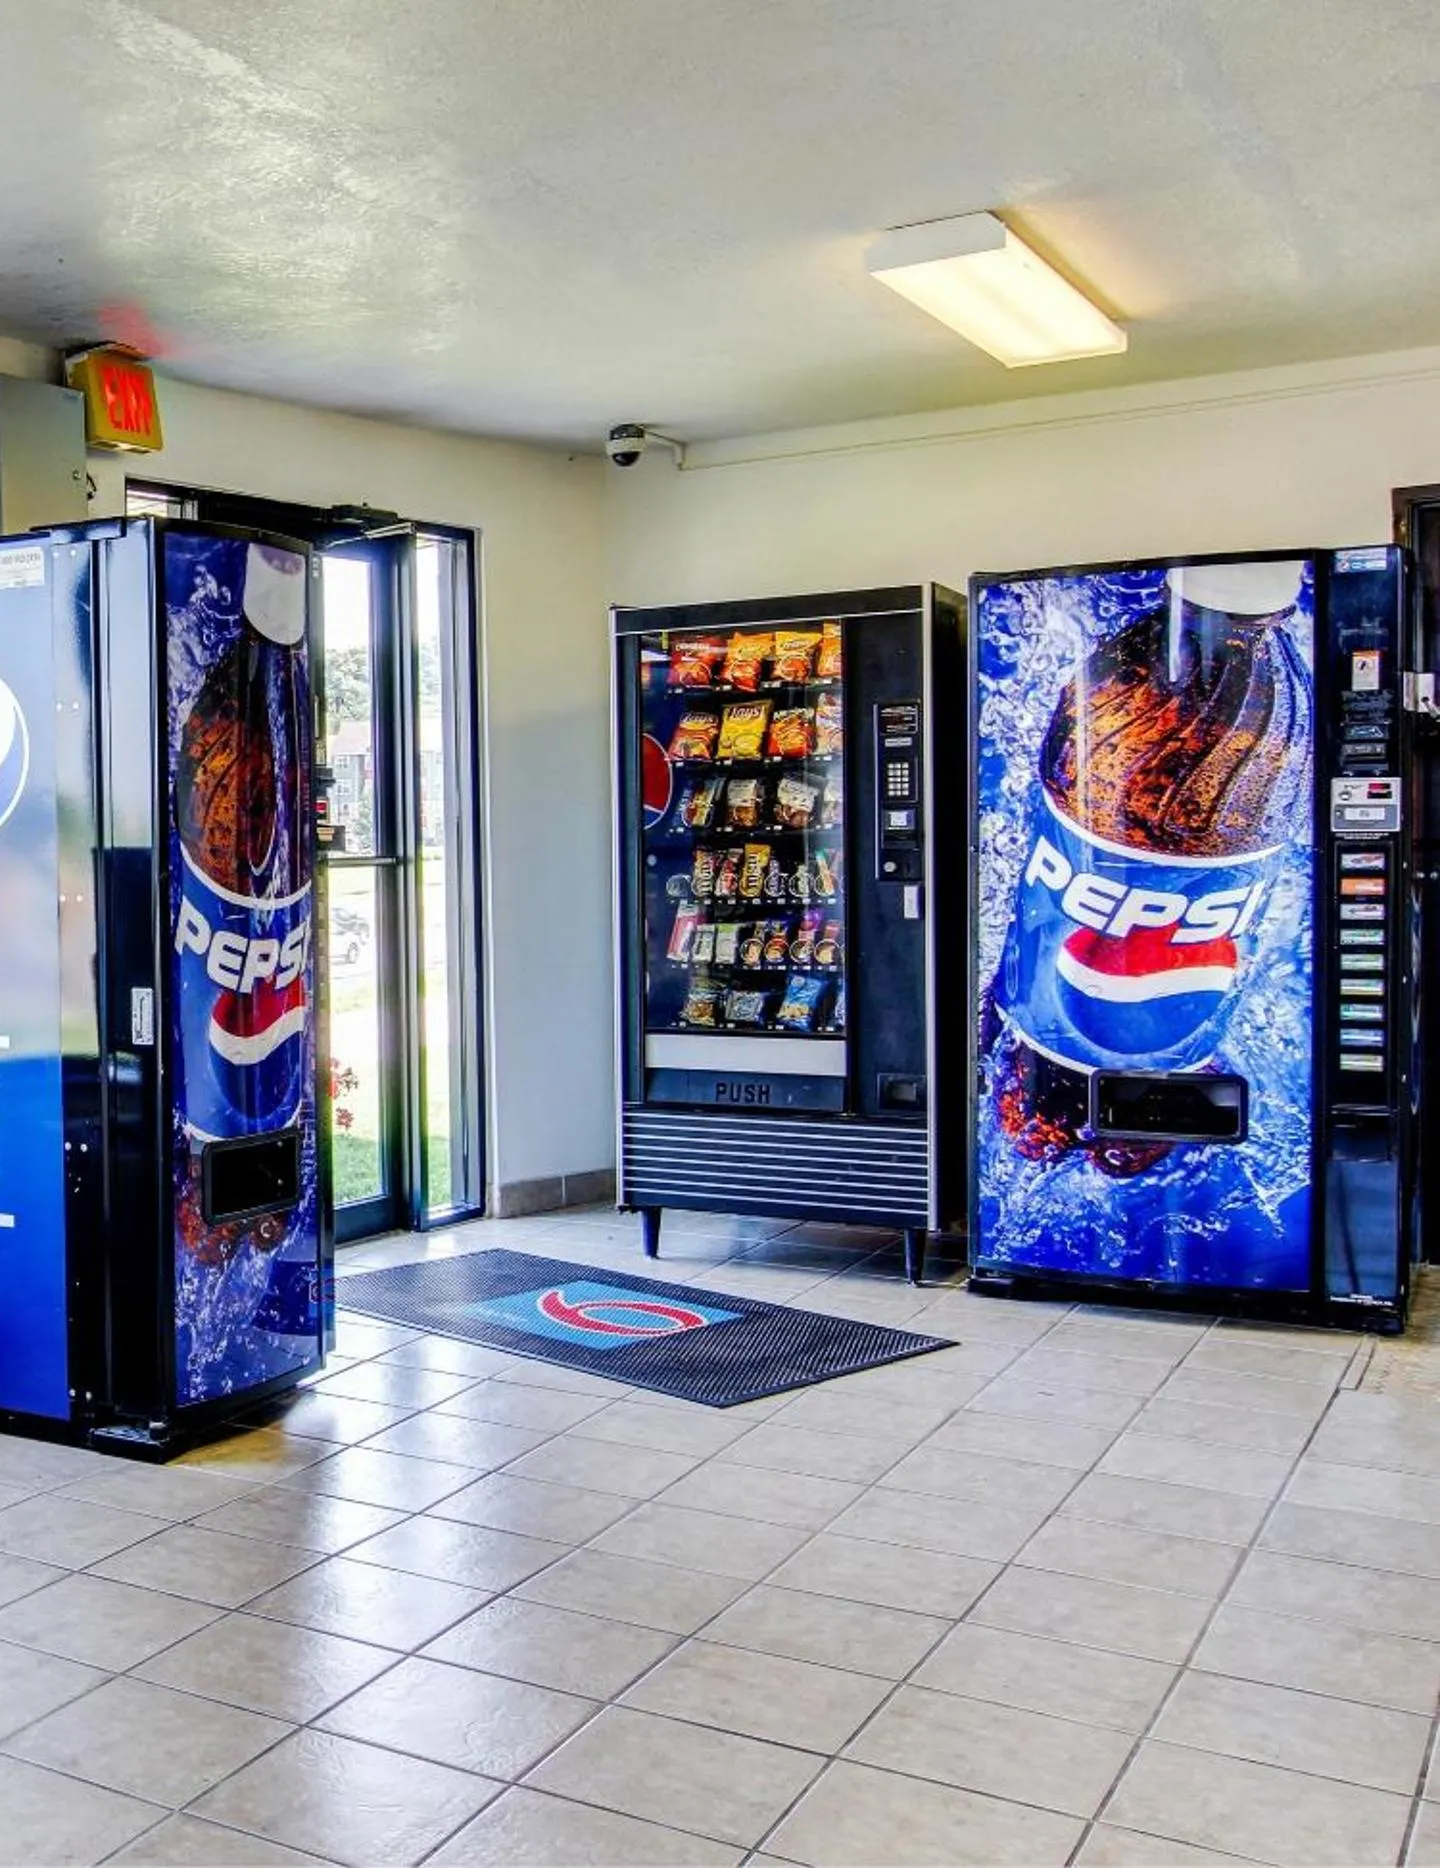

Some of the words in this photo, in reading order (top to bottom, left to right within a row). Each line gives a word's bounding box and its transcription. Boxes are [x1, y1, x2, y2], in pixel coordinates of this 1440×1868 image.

[1025, 835, 1267, 944] PEPSI
[175, 894, 312, 994] PEPSI
[715, 1082, 771, 1104] PUSH
